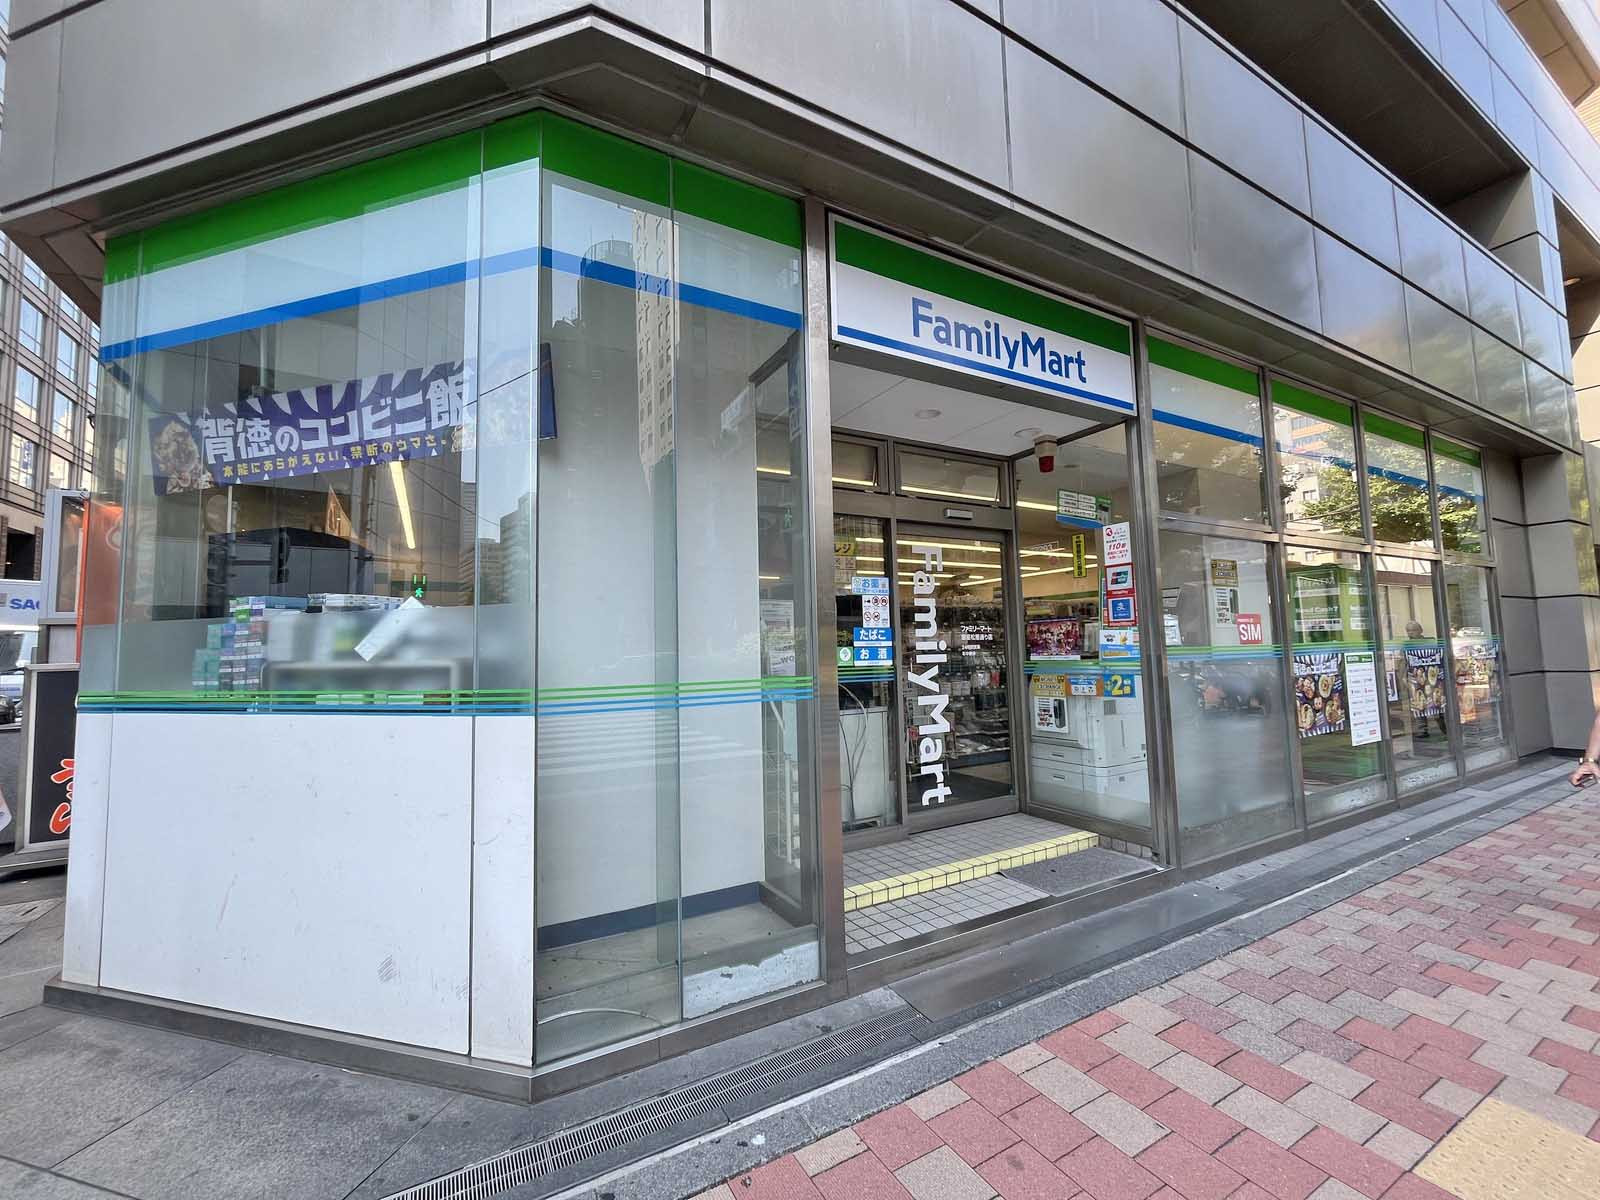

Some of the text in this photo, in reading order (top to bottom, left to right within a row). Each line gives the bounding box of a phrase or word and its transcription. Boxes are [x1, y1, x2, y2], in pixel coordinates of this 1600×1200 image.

[912, 297, 1087, 383] FamilyMart
[199, 374, 468, 464] 背徳のコンビニ飯
[9, 598, 40, 610] SA
[859, 628, 887, 640] たばこ
[1239, 623, 1262, 640] SIM
[859, 648, 888, 660] お酒
[907, 545, 952, 807] FamilyMart
